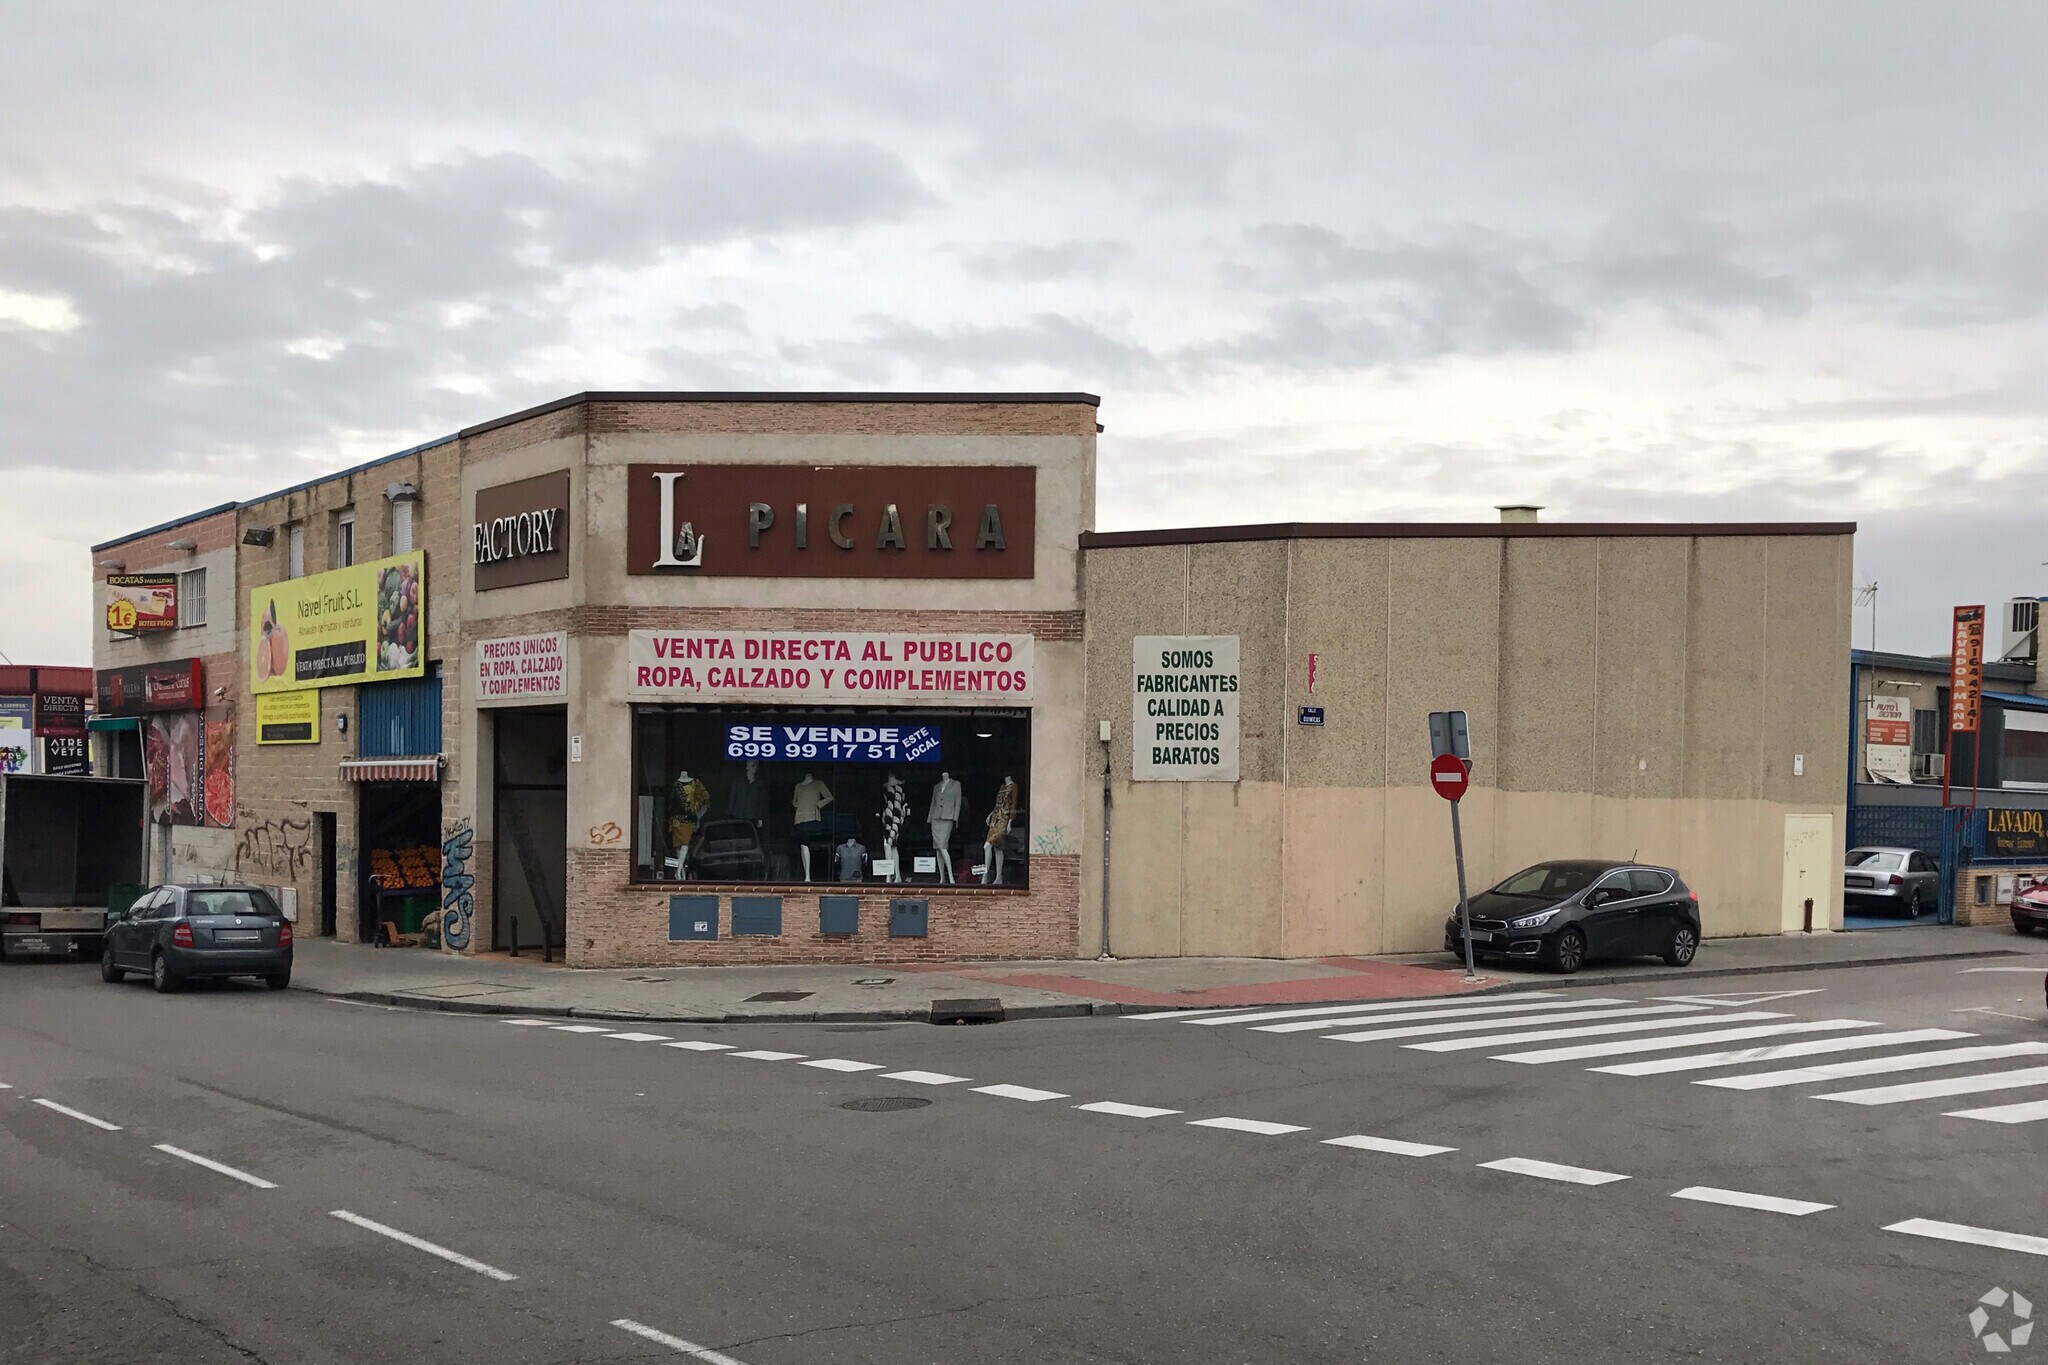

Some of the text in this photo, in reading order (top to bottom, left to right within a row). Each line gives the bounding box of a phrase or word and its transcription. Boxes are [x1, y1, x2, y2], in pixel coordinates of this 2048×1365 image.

[472, 507, 557, 564] FACTORY
[749, 502, 1005, 551] PICARA
[109, 576, 144, 584] BOCATAS
[297, 588, 363, 619] Navel Fruit S.L.
[484, 637, 558, 658] PRECIOS UNICOS
[652, 638, 1013, 663] VENTA DIRECTA AL PUBLICO
[1955, 622, 1968, 675] LAVADO
[296, 660, 313, 672] VENTA
[335, 656, 343, 667] AL
[480, 656, 563, 679] EN ROPA, CALZADO
[1161, 650, 1214, 669] SOMOS
[481, 675, 560, 695] Y COMPLEMENTOS
[637, 666, 1027, 692] ROPA, CALZADO Y COMPLEMENTOS
[1137, 674, 1238, 693] FABRICANTES
[43, 696, 79, 704] VENTA
[43, 704, 79, 712] DIRECTA
[1147, 699, 1224, 717] CALIDAD A
[1952, 692, 1967, 730] MANO
[729, 726, 899, 743] SE VENDE
[901, 726, 929, 749] ESTE
[1156, 723, 1220, 741] PRECIOS
[50, 738, 83, 747] ATRE
[50, 747, 83, 757] VETE
[727, 743, 896, 759] 699 99 17 51
[905, 736, 940, 762] LOCAL
[1152, 747, 1220, 765] BARATOS
